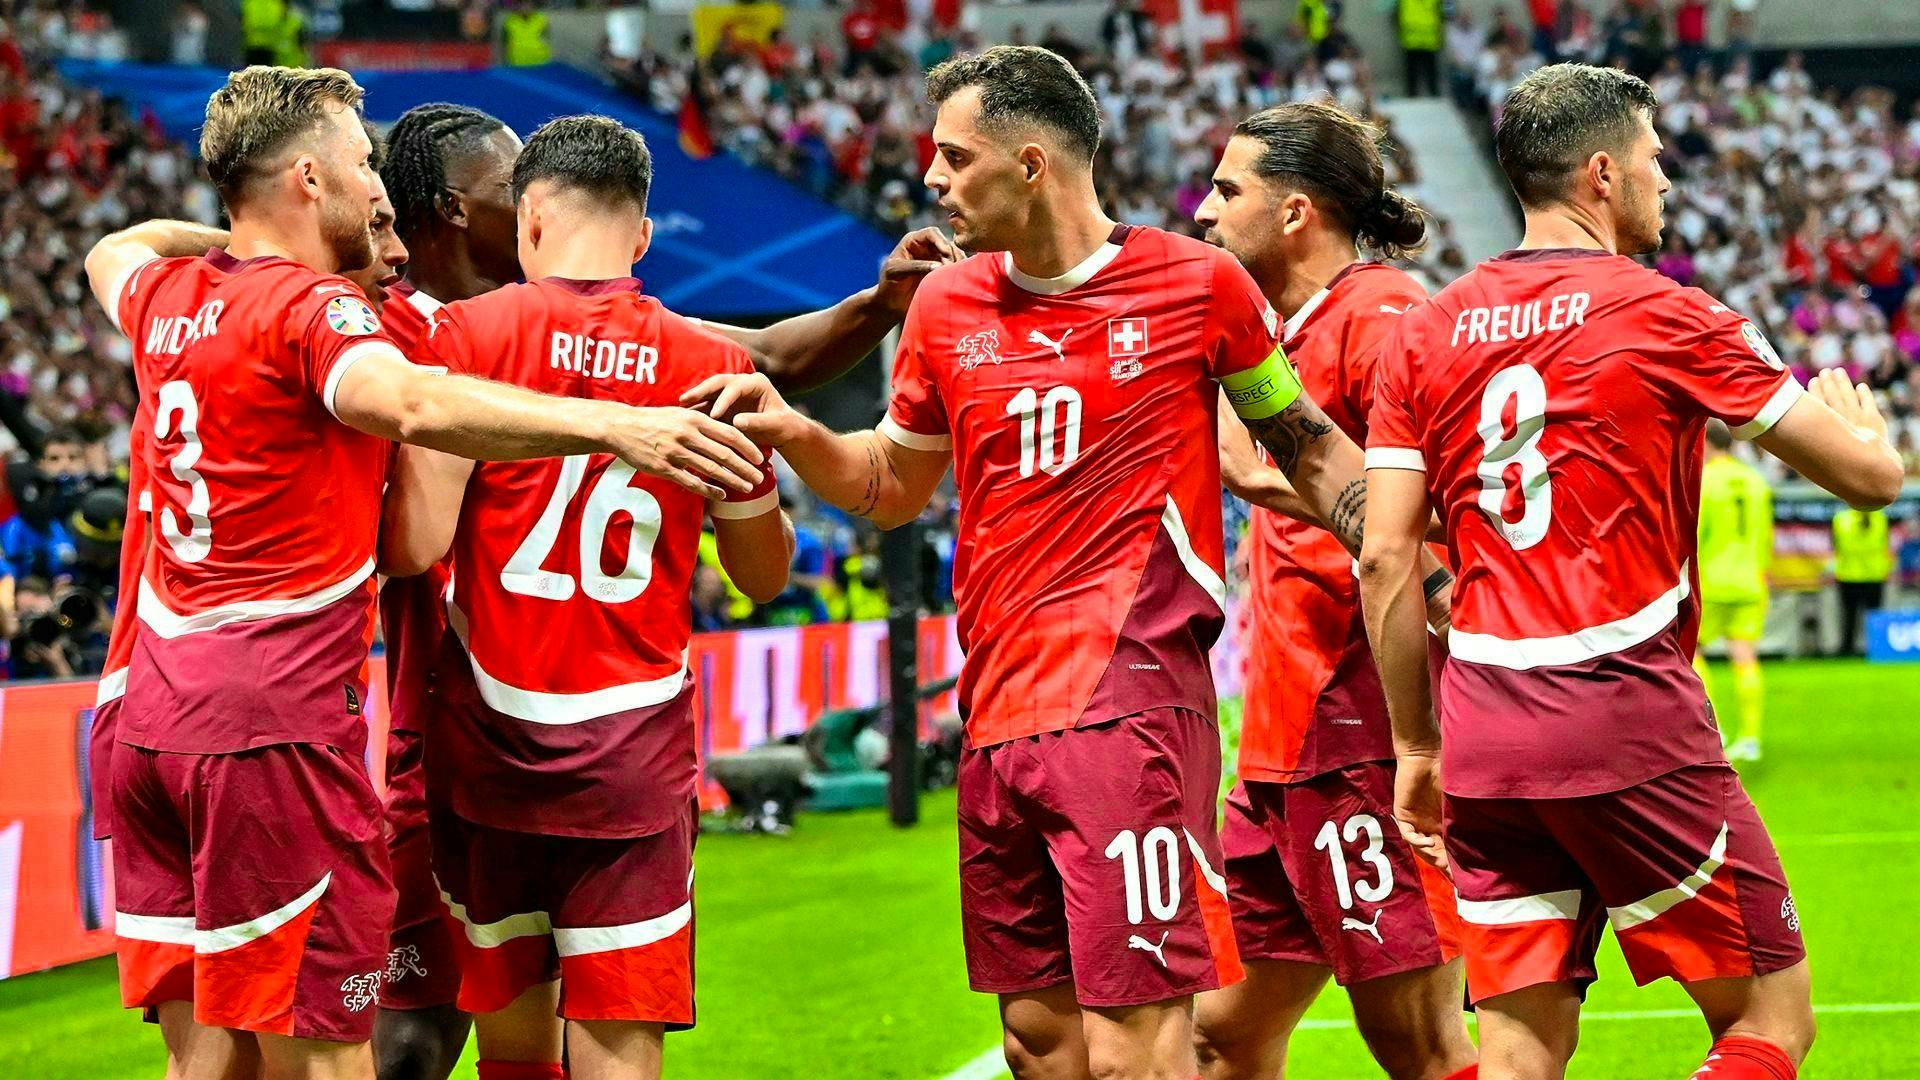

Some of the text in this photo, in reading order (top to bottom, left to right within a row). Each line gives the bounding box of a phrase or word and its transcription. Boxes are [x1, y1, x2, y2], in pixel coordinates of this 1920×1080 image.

[145, 299, 224, 354] WIDER
[550, 331, 659, 384] RIEDER
[1451, 292, 1590, 347] FREULER
[154, 380, 211, 563] 3
[1006, 385, 1082, 478] 10
[1477, 364, 1552, 550] 8
[500, 453, 662, 603] 26
[1104, 826, 1180, 925] 10
[1314, 814, 1394, 910] 13
